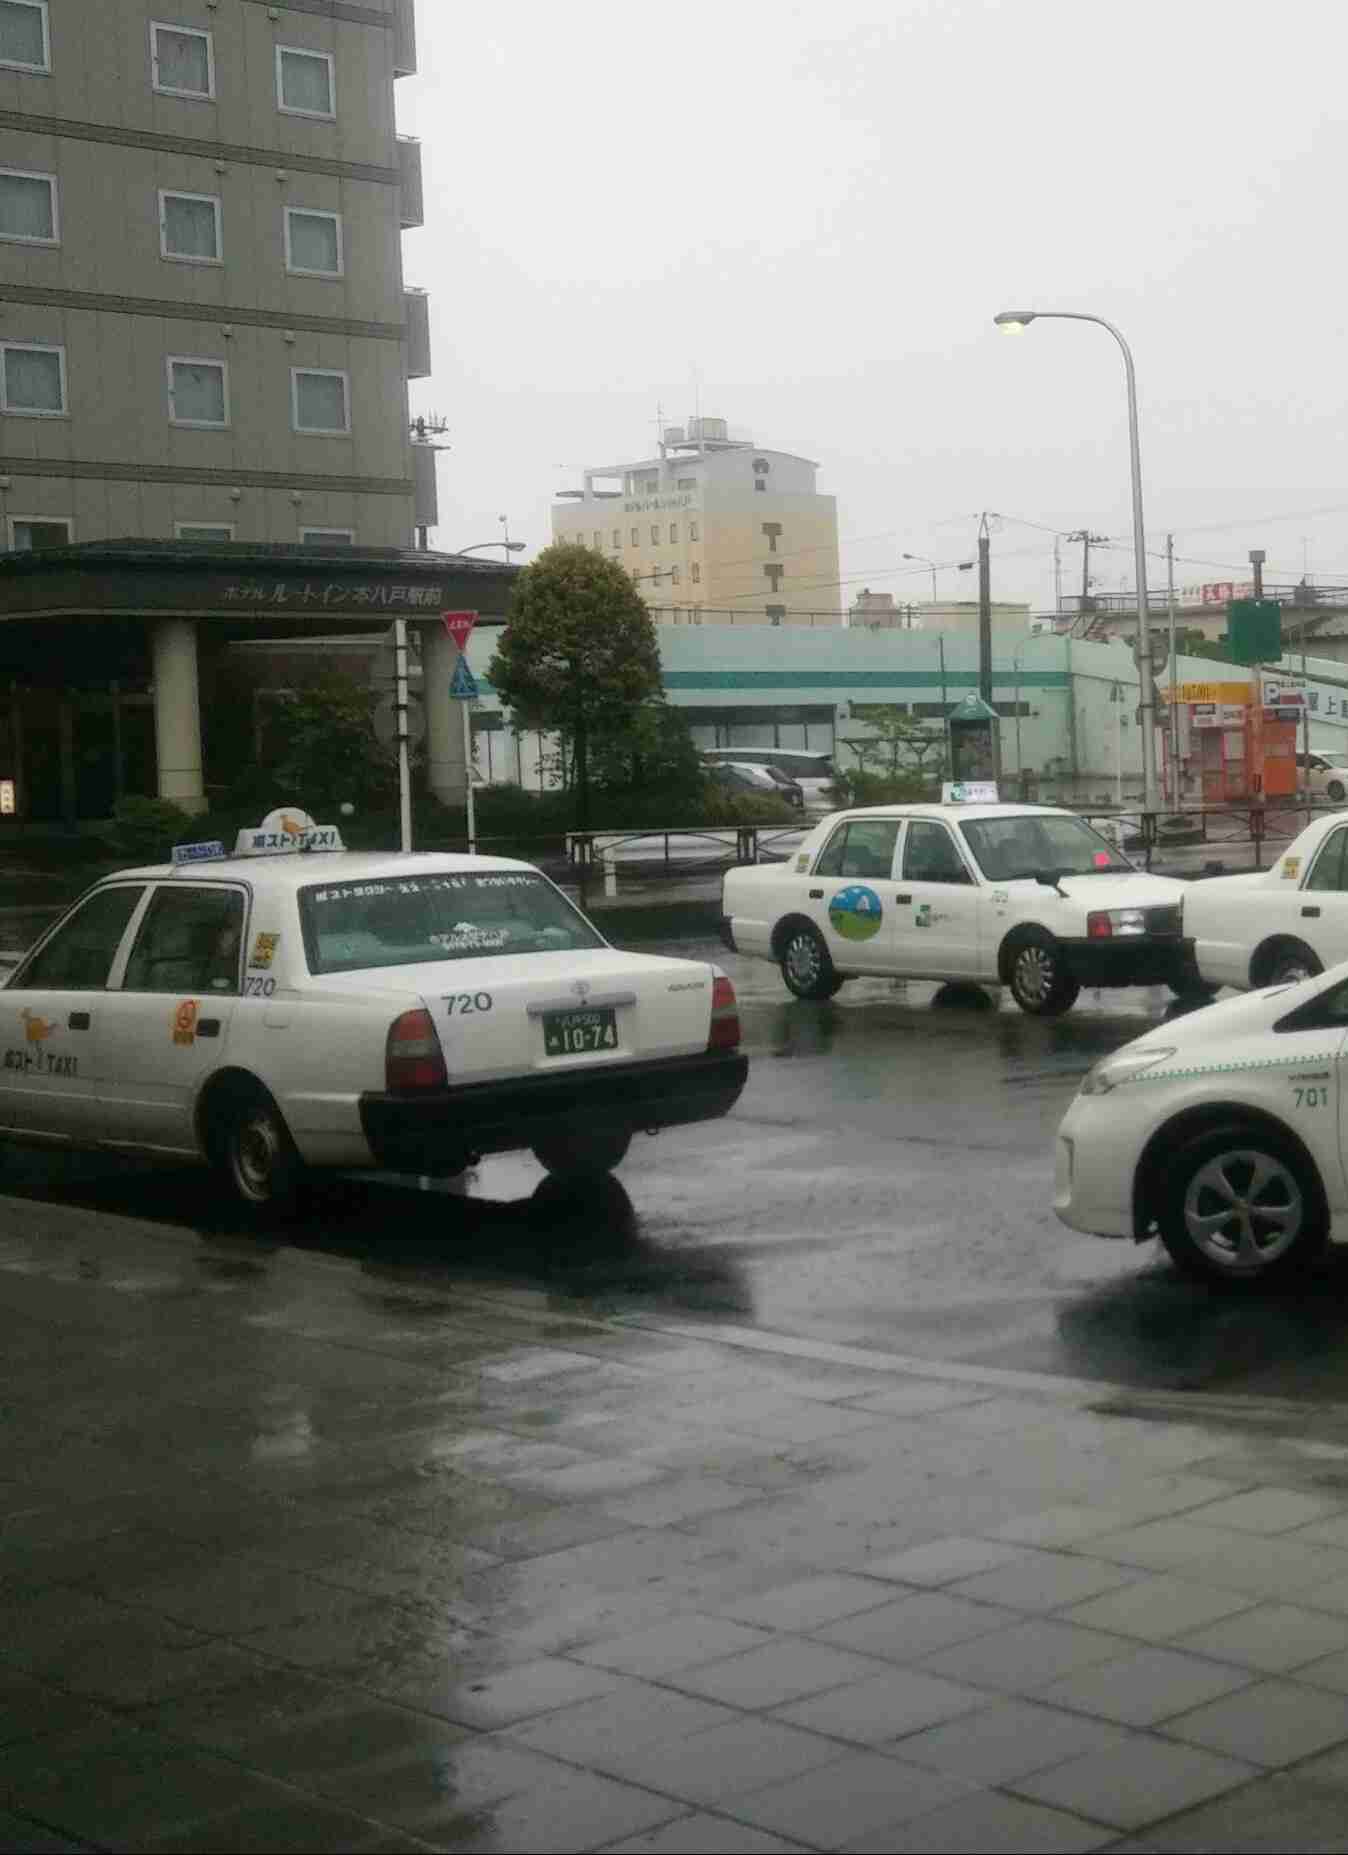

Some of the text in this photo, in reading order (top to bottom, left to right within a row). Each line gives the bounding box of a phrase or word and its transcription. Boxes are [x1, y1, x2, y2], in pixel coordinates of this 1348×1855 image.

[242, 976, 276, 997] 720
[440, 992, 494, 1016] 720
[1292, 1087, 1329, 1109] 701
